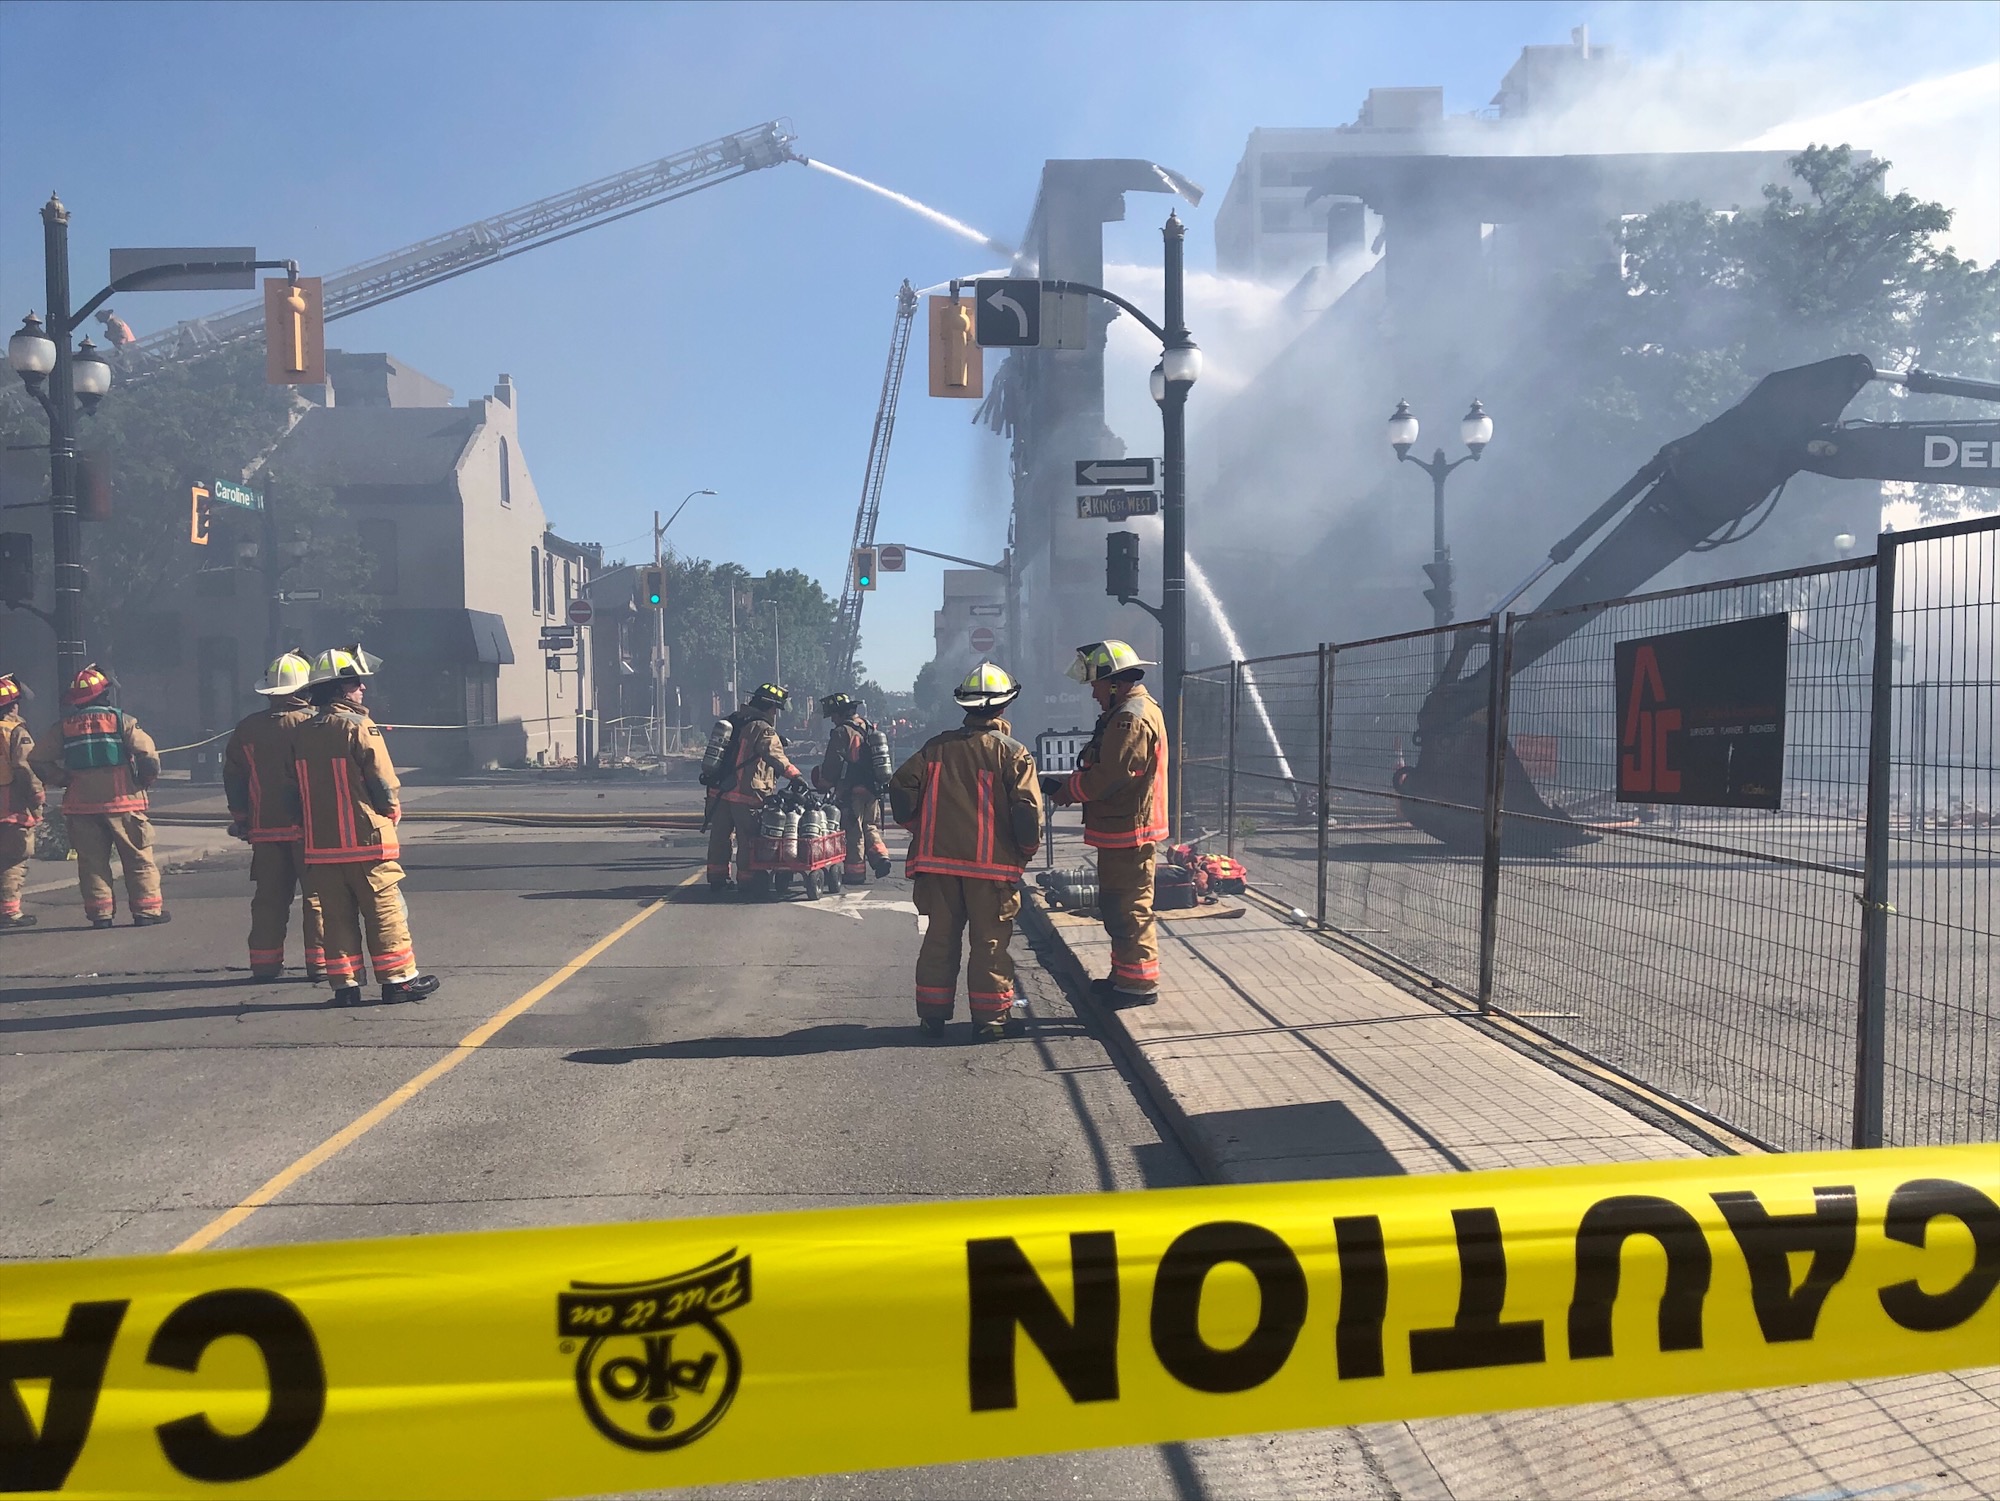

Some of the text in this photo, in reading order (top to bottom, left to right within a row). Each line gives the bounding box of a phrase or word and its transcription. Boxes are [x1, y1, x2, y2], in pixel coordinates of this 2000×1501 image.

[215, 481, 250, 506] Caroline
[1093, 498, 1116, 514] KING
[1127, 496, 1151, 513] WEST
[568, 1266, 743, 1329] Put it on
[967, 1178, 2000, 1413] CAUTION
